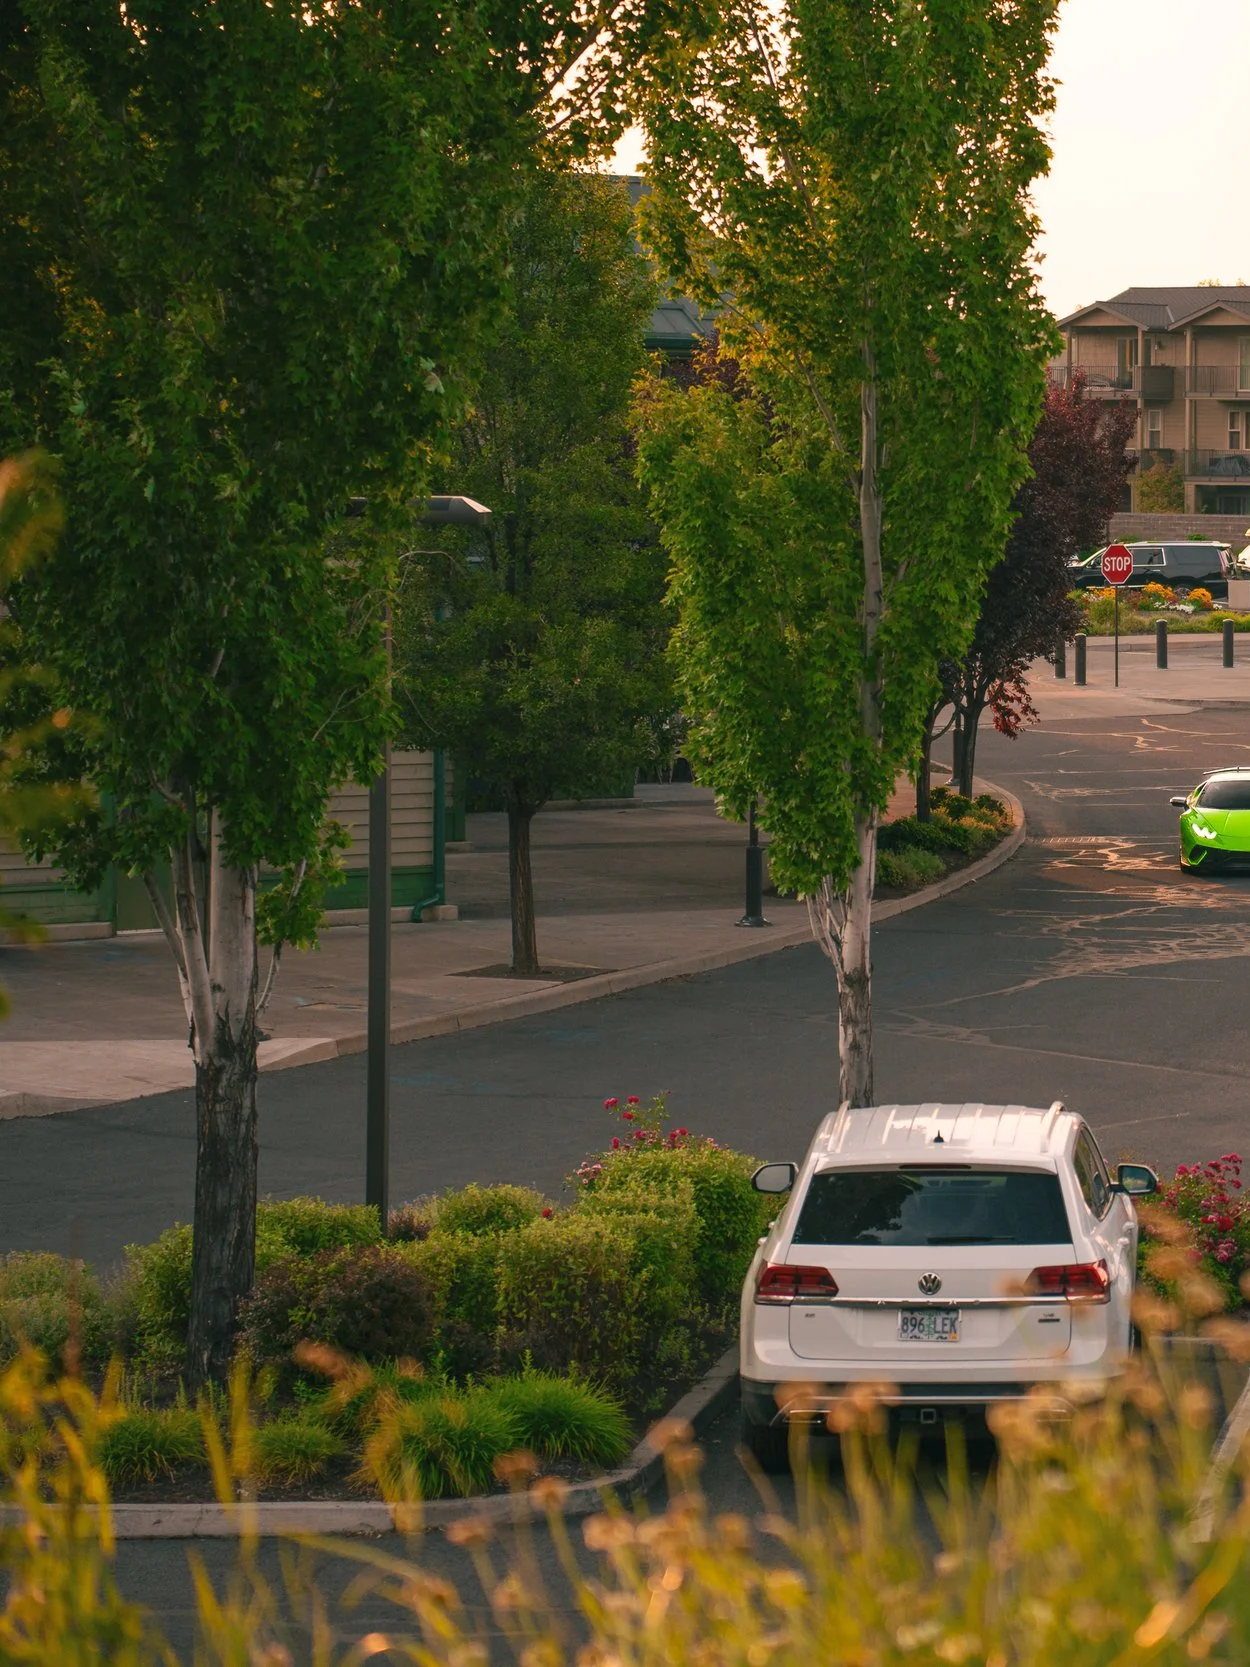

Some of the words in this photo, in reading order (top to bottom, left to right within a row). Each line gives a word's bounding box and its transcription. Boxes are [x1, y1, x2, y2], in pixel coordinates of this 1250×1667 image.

[1103, 556, 1131, 572] STOP
[901, 1316, 925, 1334] 896
[933, 1316, 957, 1334] LEK
